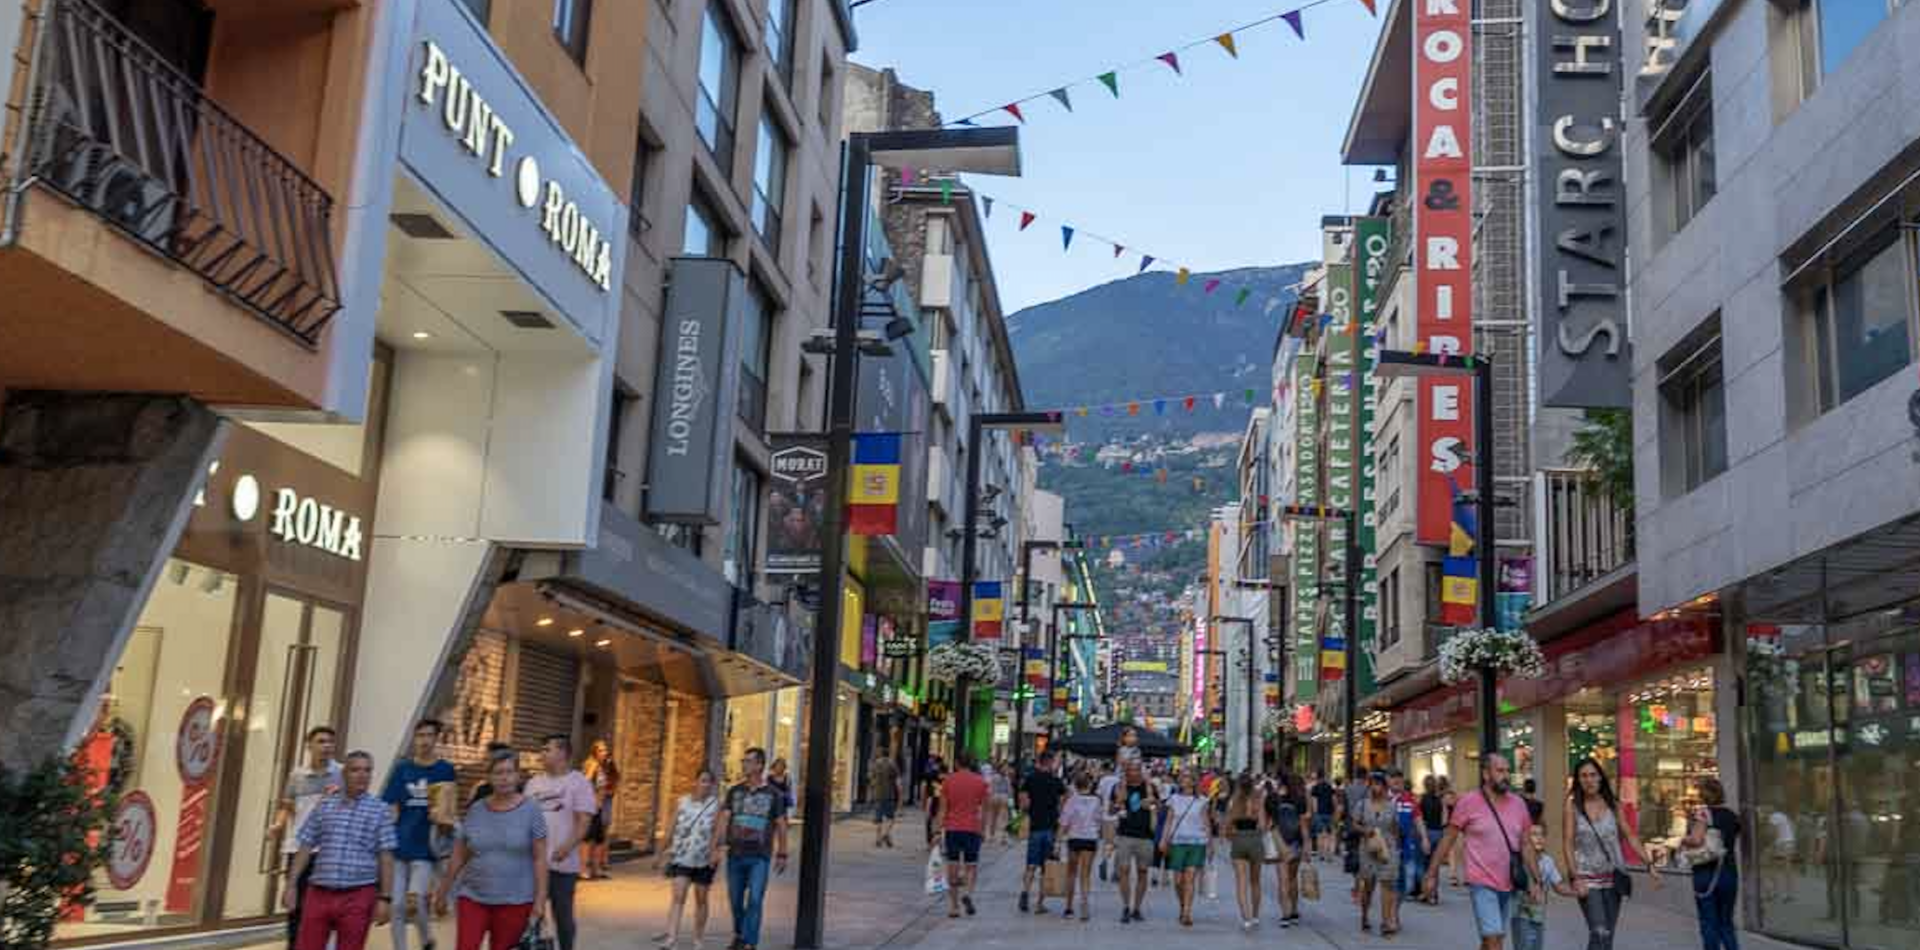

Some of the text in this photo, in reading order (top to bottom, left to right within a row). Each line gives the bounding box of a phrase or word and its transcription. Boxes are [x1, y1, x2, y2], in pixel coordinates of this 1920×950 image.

[418, 41, 612, 292] PUNT ROMA
[1425, 179, 1458, 210] &
[1553, 114, 1620, 355] STARC
[665, 319, 700, 456] LONGINES
[1331, 349, 1351, 510] CAFETERIA
[270, 487, 362, 561] ROMA
